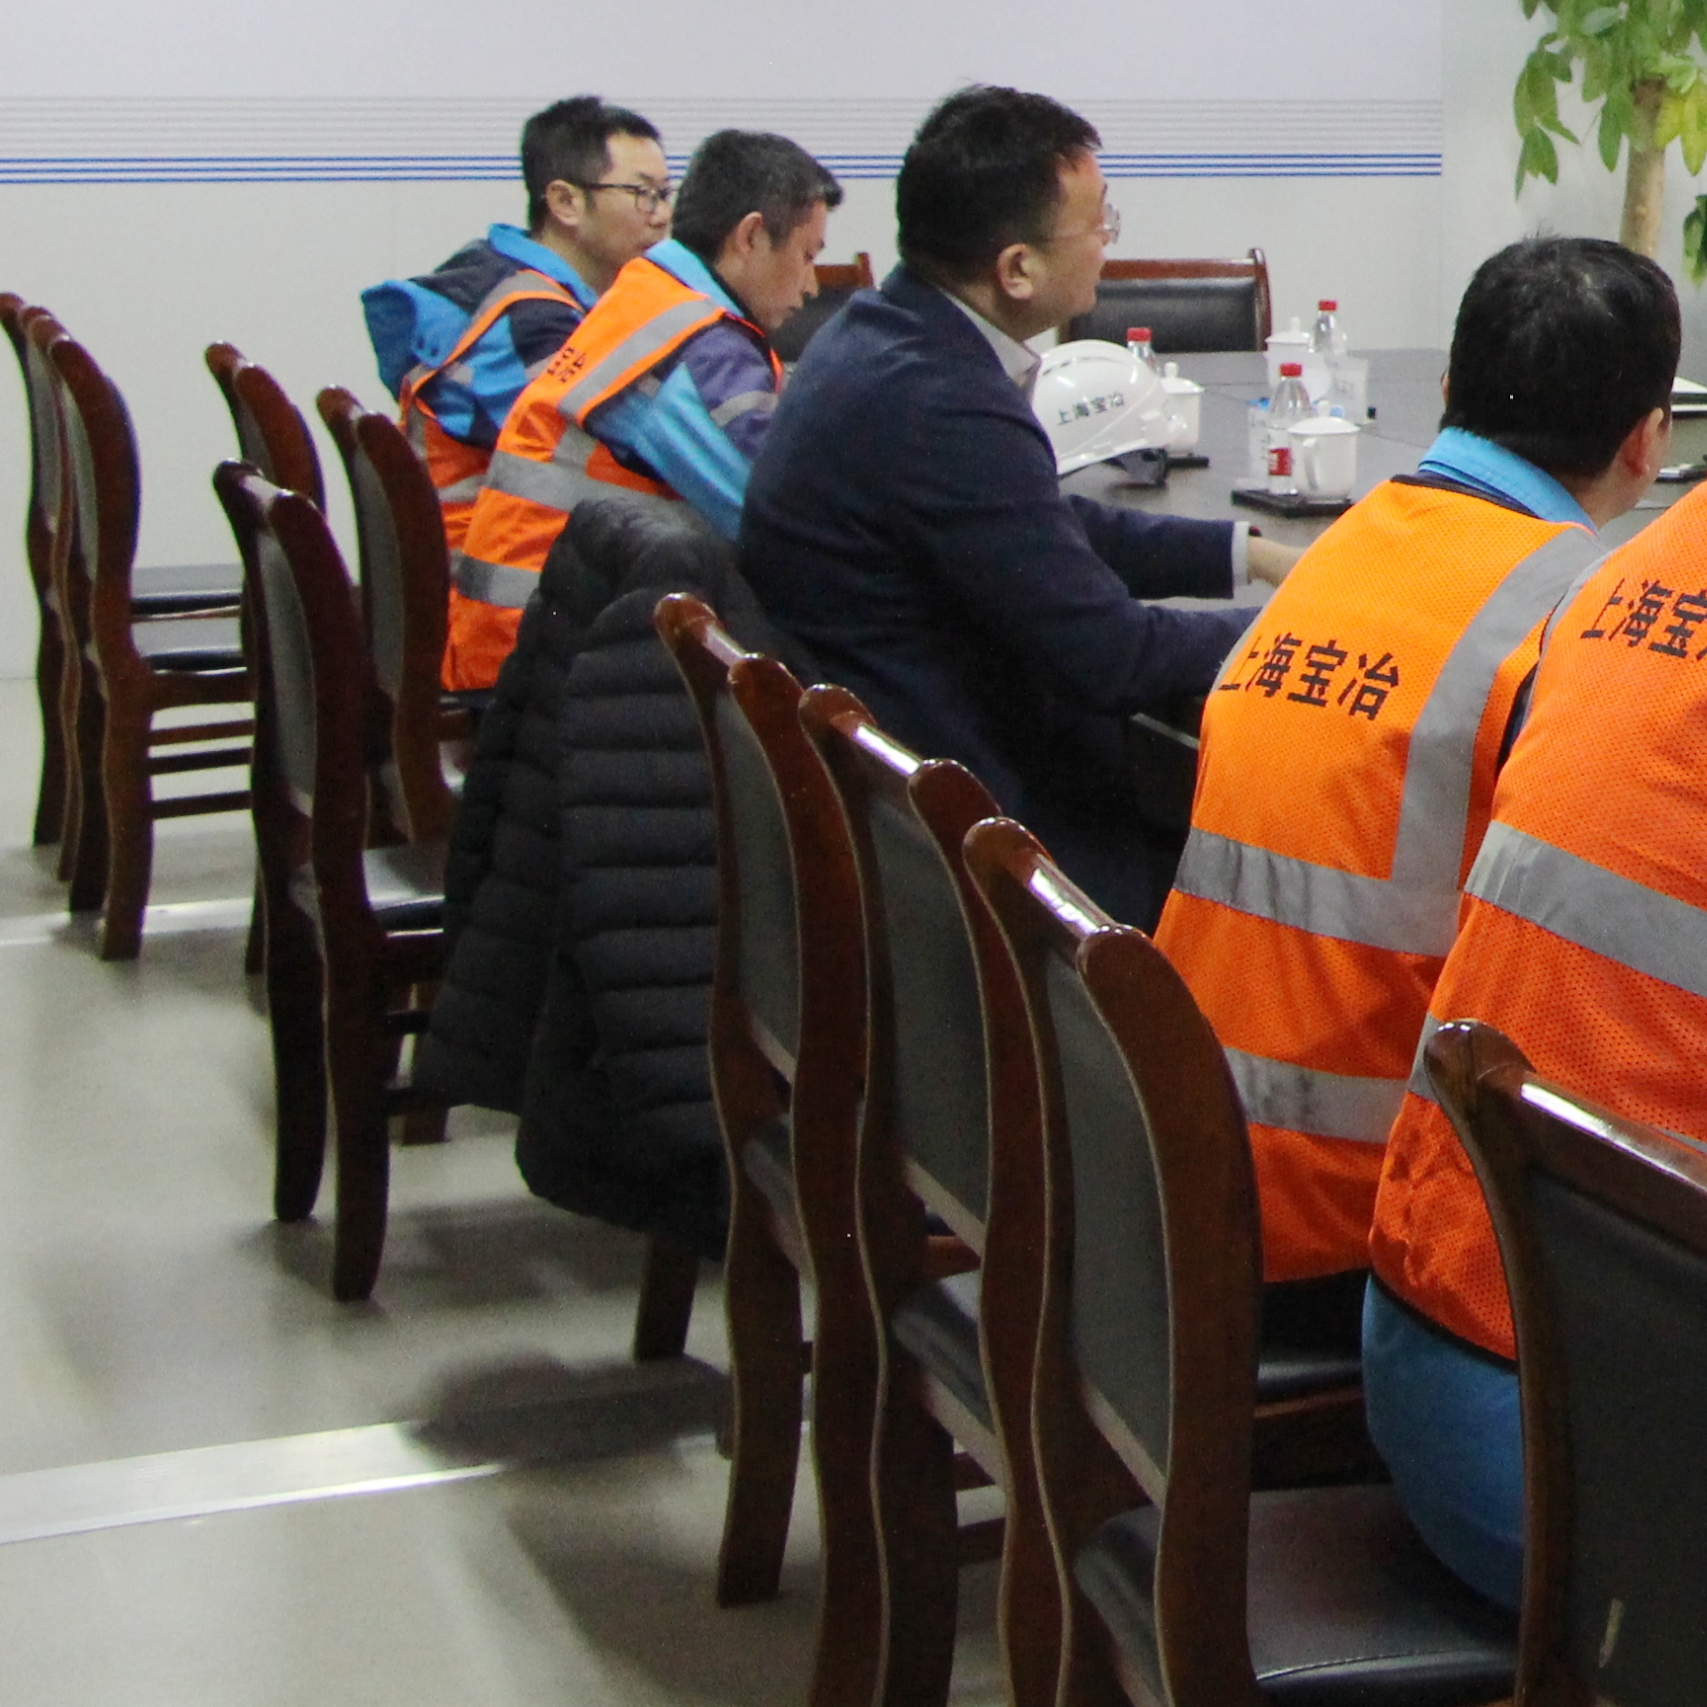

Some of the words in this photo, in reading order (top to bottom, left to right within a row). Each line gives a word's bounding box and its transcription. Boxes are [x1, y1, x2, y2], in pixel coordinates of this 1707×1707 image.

[1057, 391, 1124, 426] 上海宝冶
[1220, 632, 1400, 721] 上海宝冶
